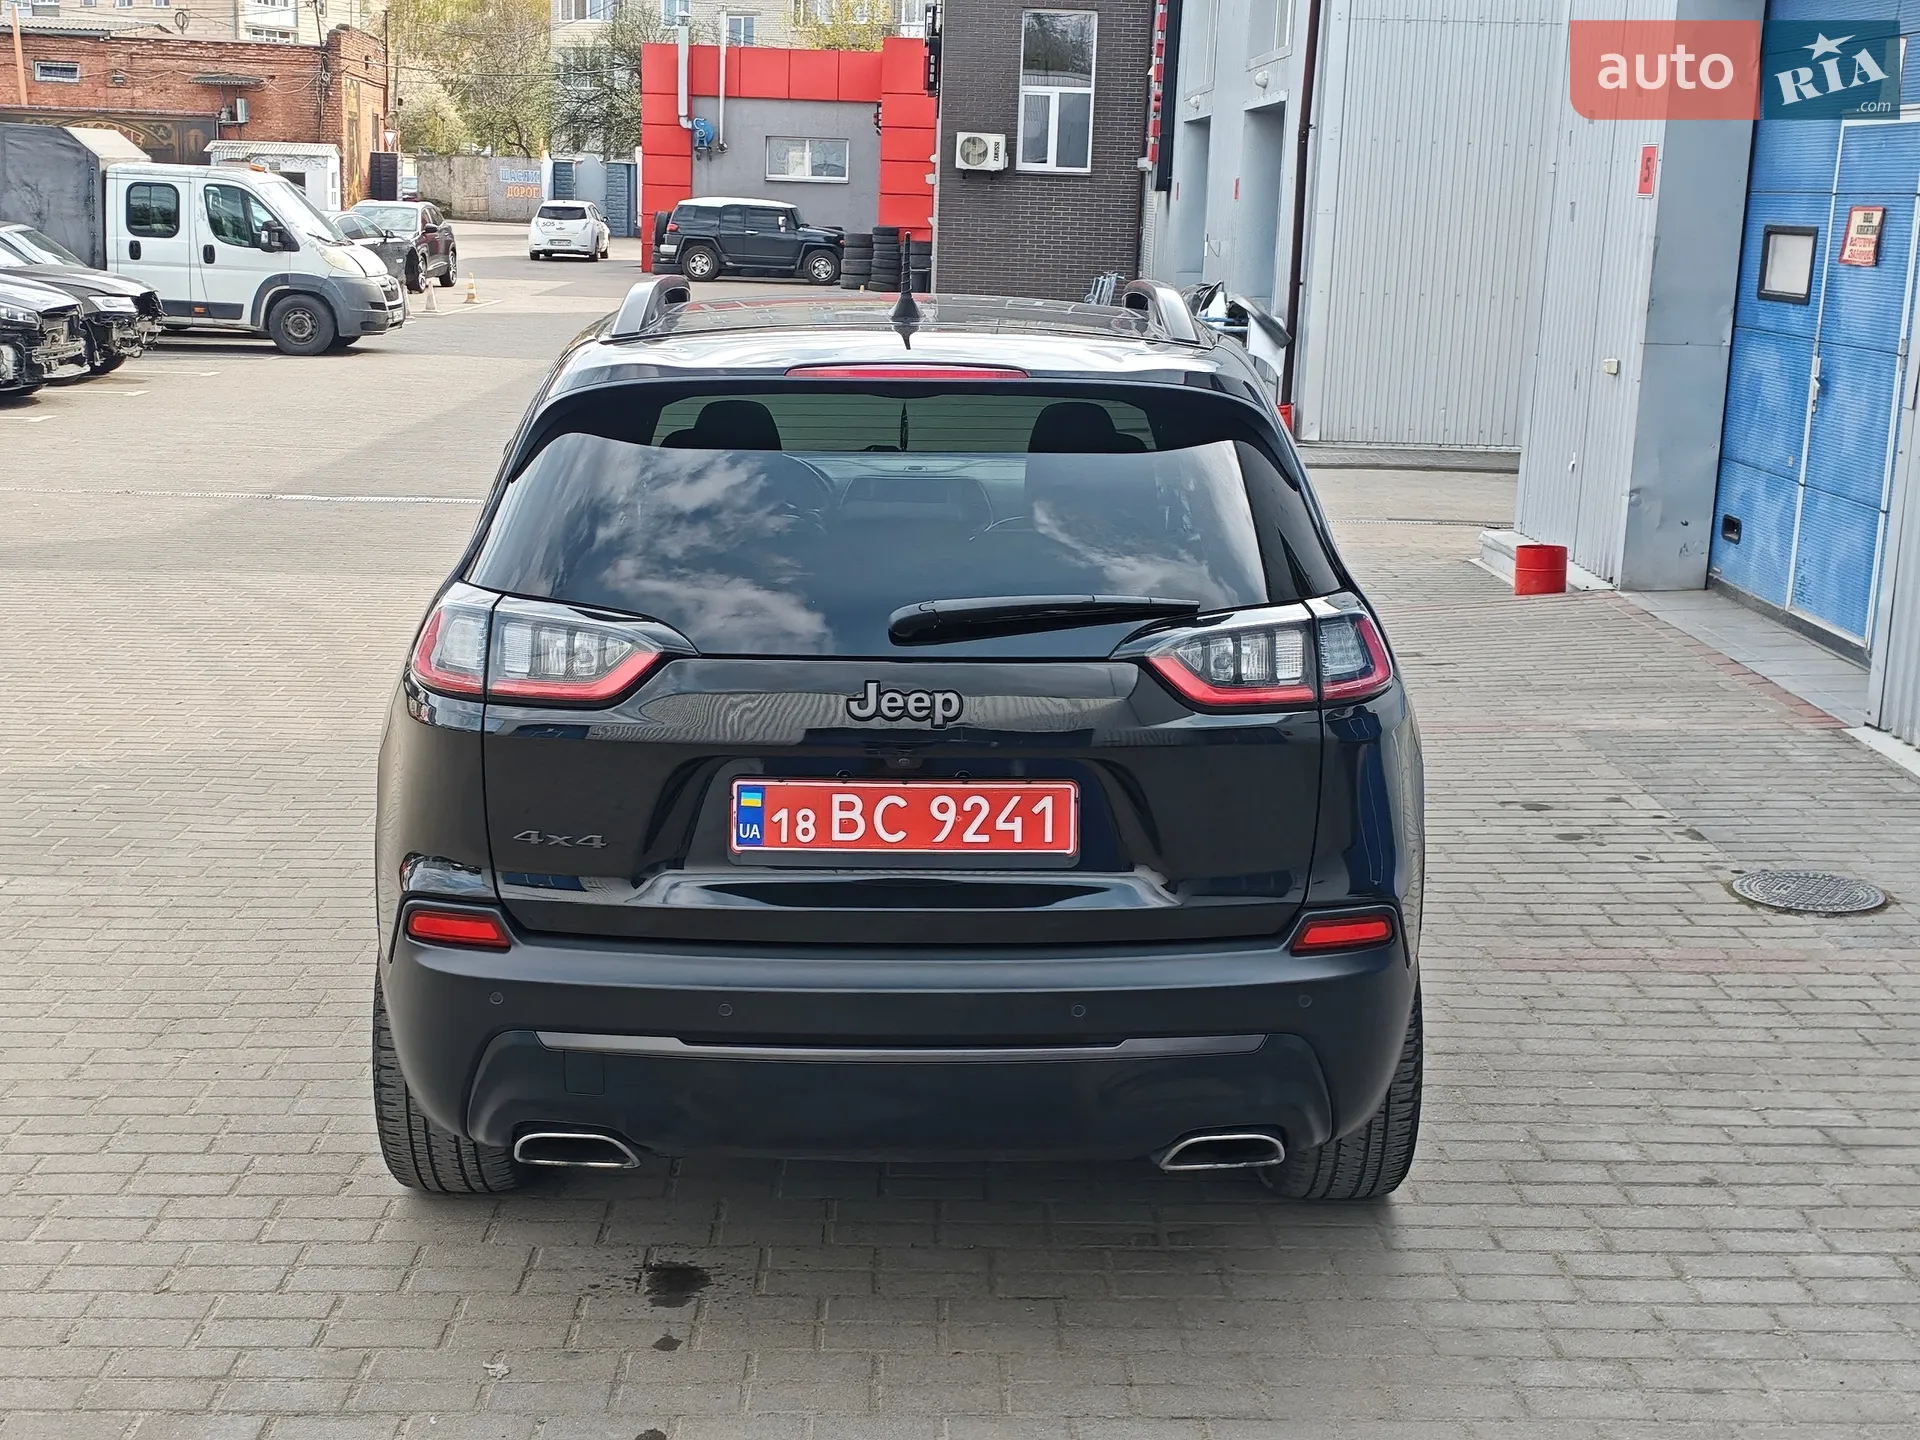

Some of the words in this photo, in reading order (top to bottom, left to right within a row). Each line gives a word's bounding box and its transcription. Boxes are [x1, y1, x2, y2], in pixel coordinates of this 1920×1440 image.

[506, 185, 543, 199] ДОРОГ
[848, 681, 962, 729] Jeep
[739, 823, 761, 840] UA
[770, 808, 817, 844] 18
[831, 793, 908, 843] BC
[929, 794, 1054, 844] 9241
